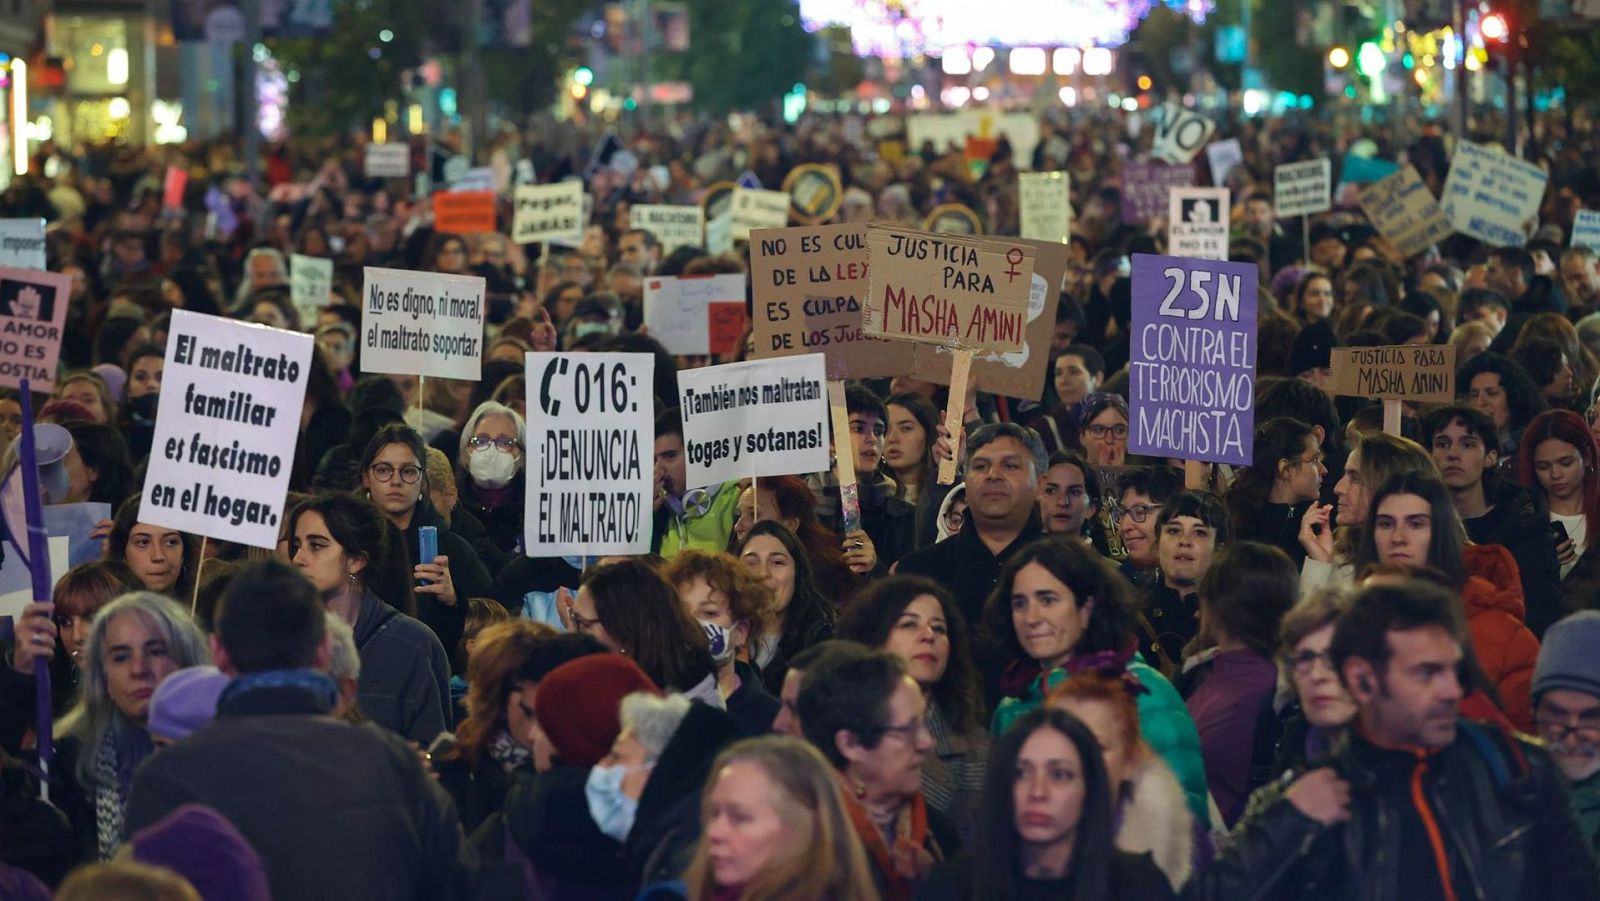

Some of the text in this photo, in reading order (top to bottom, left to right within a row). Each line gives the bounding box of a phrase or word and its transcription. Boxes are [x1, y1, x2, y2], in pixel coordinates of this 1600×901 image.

[761, 233, 867, 257] NO ES CUL
[887, 234, 979, 267] JUSTICIA
[772, 261, 869, 287] DE LA LEY
[942, 266, 995, 295] PARA
[1158, 267, 1241, 322] 25N
[369, 283, 482, 325] No es digno, ni moral,
[766, 295, 860, 322] ES CULPA
[883, 284, 1023, 346] MASHA AMINI
[4, 320, 59, 341] AMOR
[23, 344, 46, 360] ES
[367, 321, 479, 361] el maltrato soportar.
[771, 323, 891, 352] DE LOS JUE
[1142, 323, 1253, 369] CONTRA EL
[174, 333, 299, 384] El maltrato
[1351, 349, 1446, 367] JUSTICIA PARA
[574, 362, 637, 414] 016:
[683, 376, 821, 423] ¡También nos maltratan
[1133, 361, 1252, 412] TERRORISMO
[1357, 367, 1449, 395] MASHA AMINI
[184, 382, 277, 428] familiar
[687, 421, 823, 469] togas y sotanas!
[1138, 406, 1245, 458] MACHISTA
[164, 432, 282, 478] es fascismo
[540, 428, 642, 488] ¡DENUNCIA
[150, 482, 277, 526] en el hogar.
[538, 491, 641, 543] EL MALTRATO!
